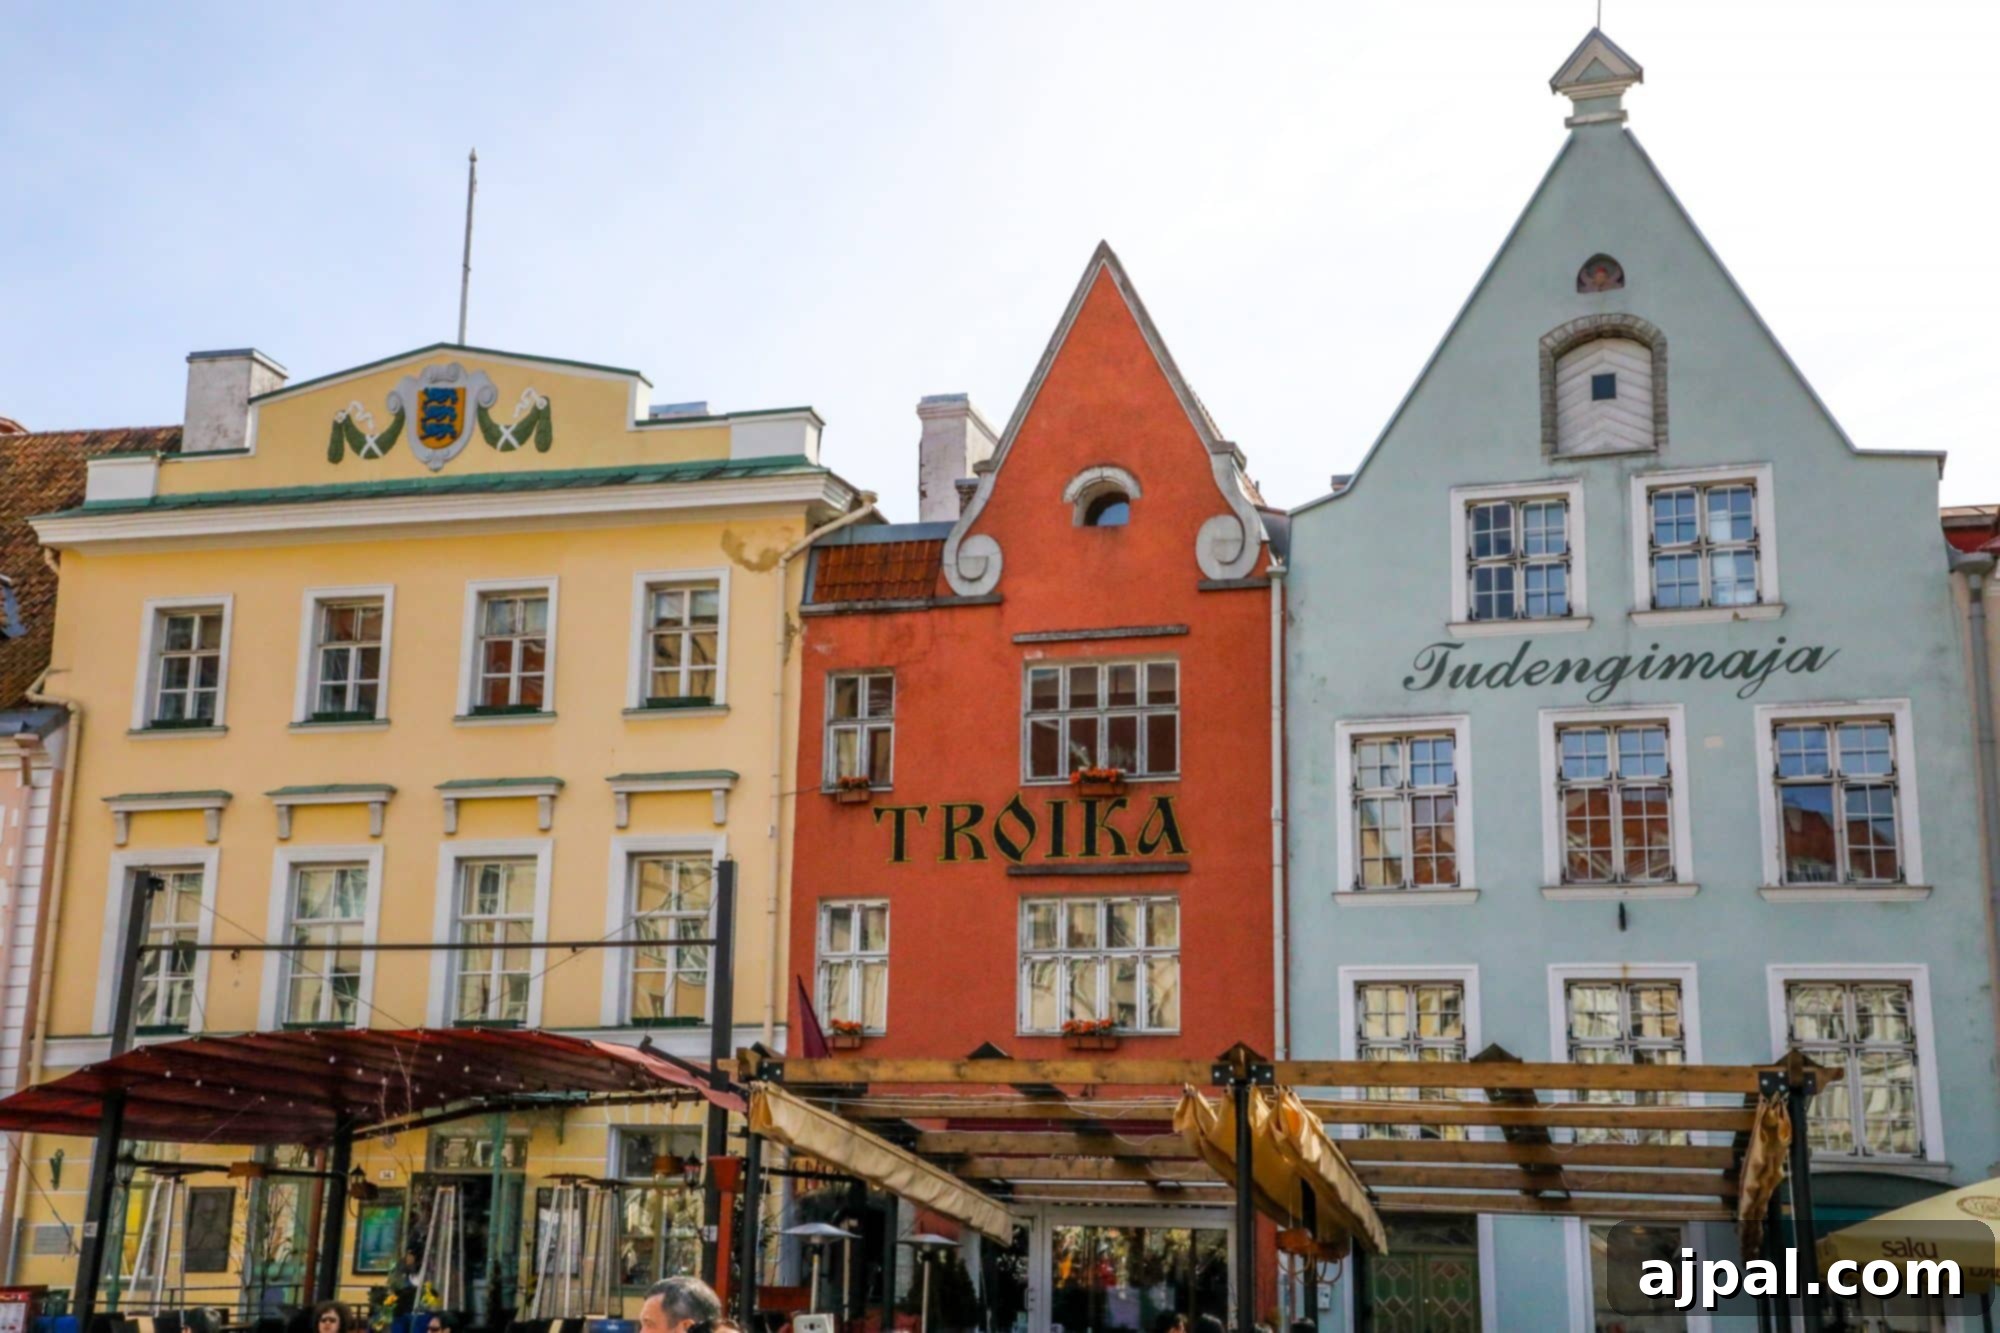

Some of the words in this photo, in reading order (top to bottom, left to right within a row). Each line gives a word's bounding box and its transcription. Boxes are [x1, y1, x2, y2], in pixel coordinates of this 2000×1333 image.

[1403, 636, 1840, 703] Tudengimaja
[873, 792, 1191, 865] TROIKA
[1881, 1236, 1939, 1259] saku
